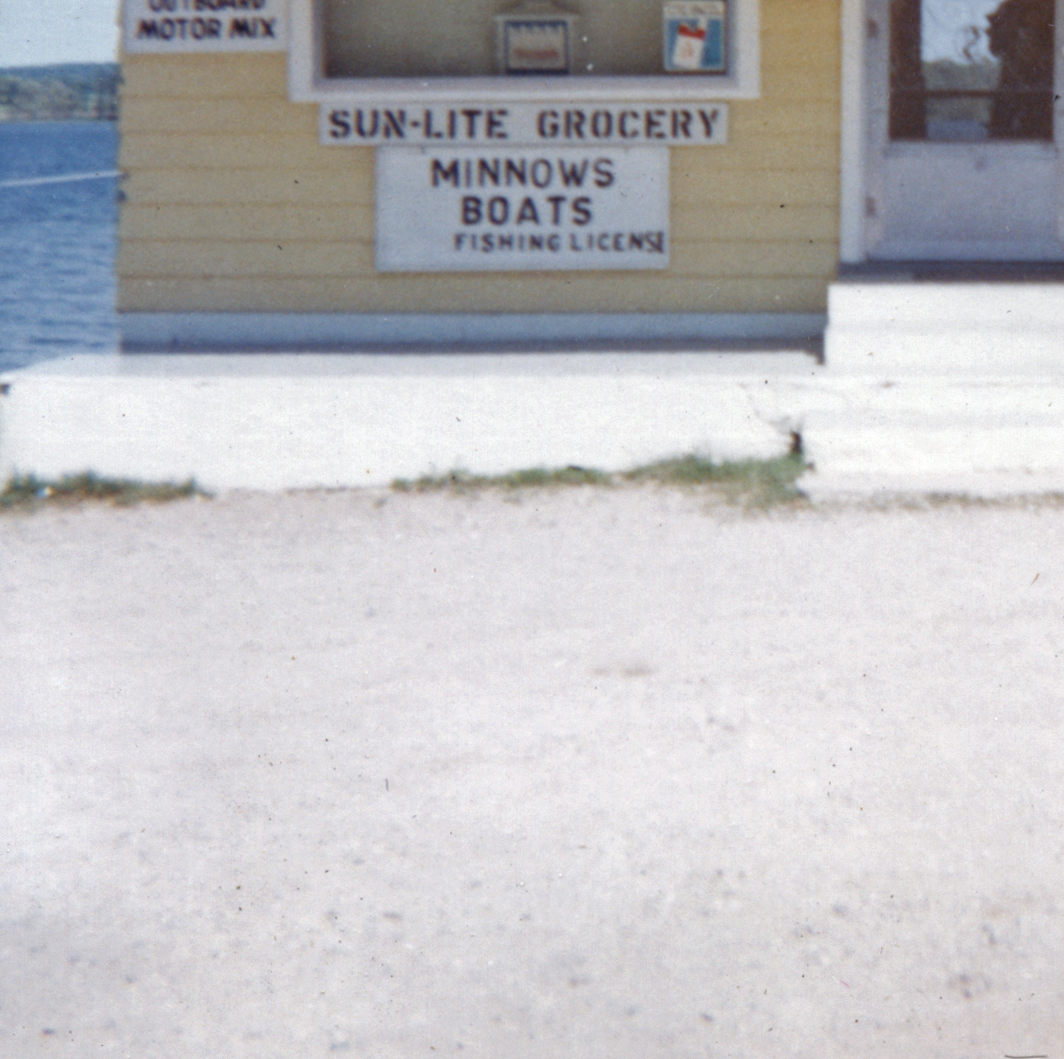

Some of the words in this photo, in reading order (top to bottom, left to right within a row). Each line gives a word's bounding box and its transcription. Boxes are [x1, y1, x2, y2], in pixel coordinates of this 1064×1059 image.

[137, 17, 221, 40] MOTOR
[228, 17, 276, 39] MIX
[329, 108, 508, 139] SUN-LITE
[537, 108, 720, 139] GROCERY
[431, 158, 615, 188] MINNOWS
[461, 196, 592, 226] BOATS
[454, 232, 559, 253] FISHING
[570, 231, 665, 254] LICENSE
